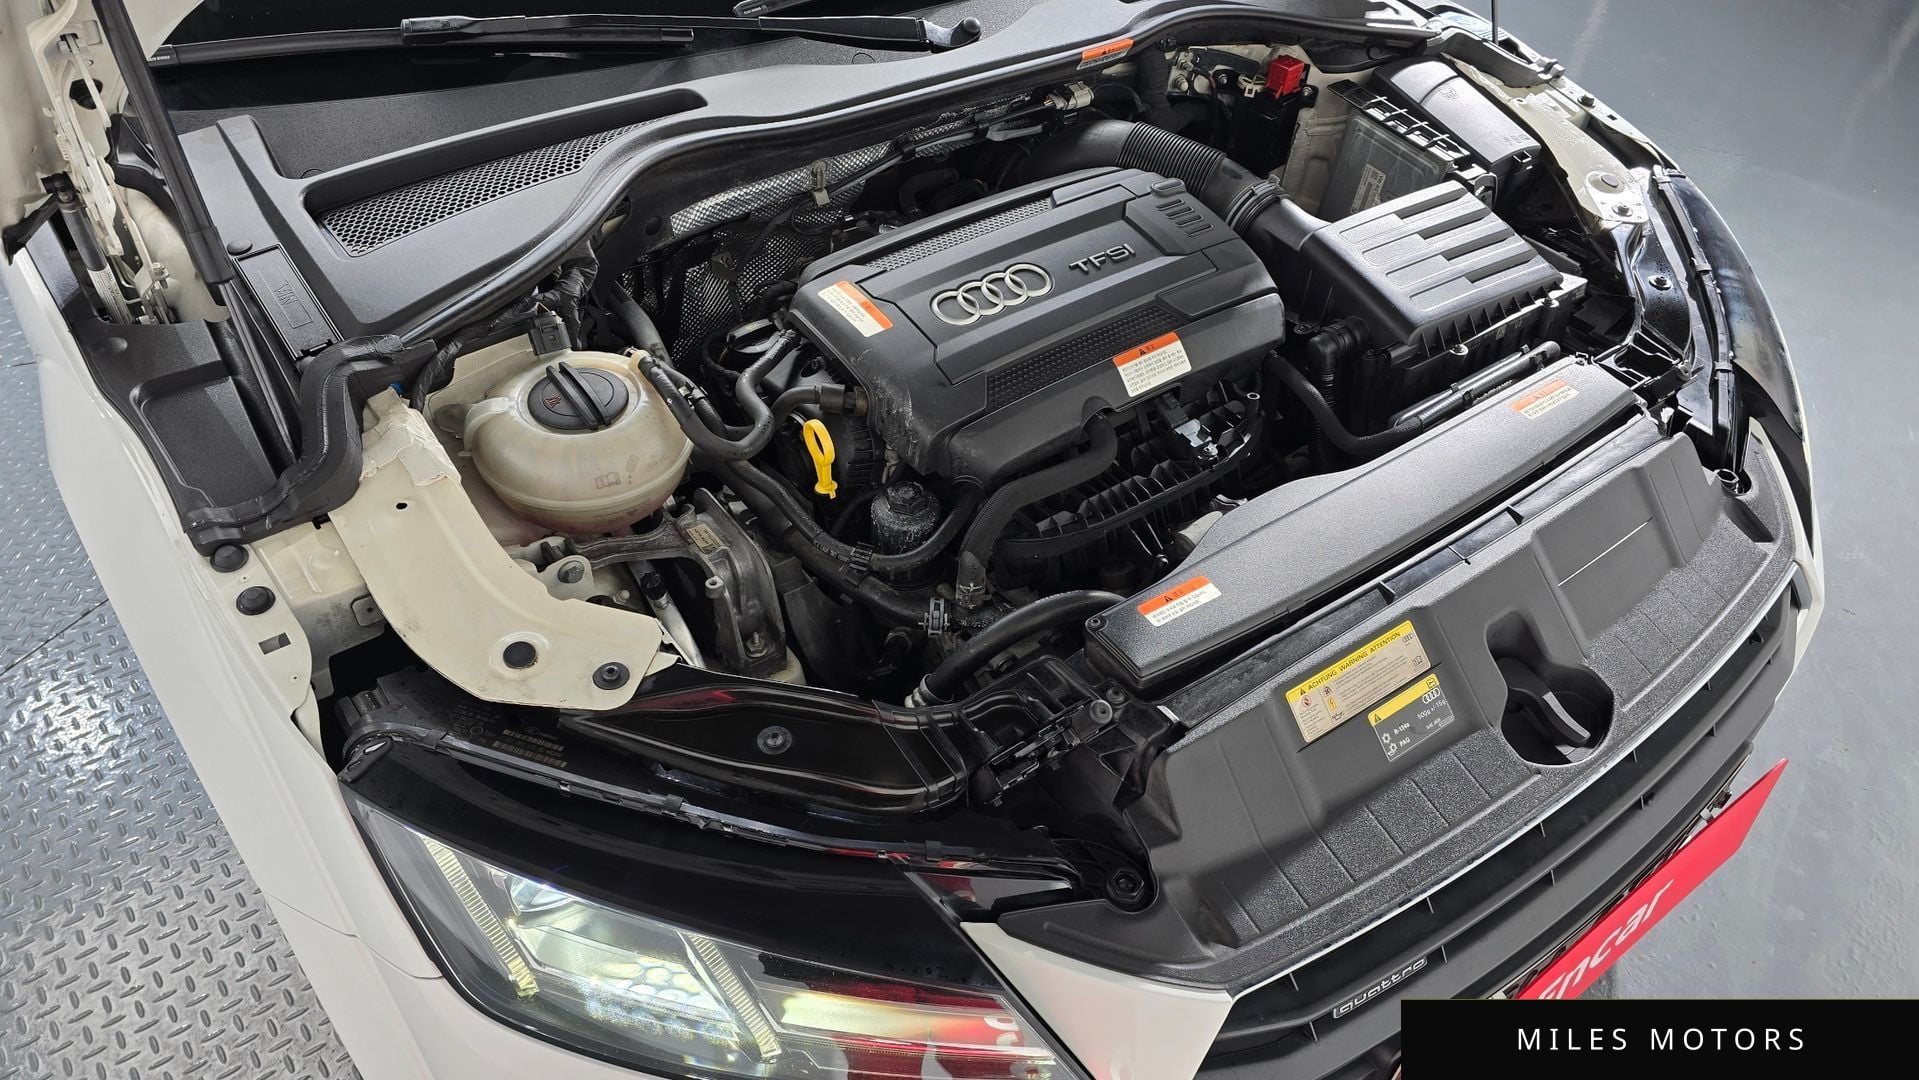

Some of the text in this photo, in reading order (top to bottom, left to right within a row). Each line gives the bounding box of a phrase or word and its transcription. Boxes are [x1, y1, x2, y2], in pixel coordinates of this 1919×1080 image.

[1068, 243, 1136, 274] TFSI
[1308, 631, 1401, 691] ACHTUNG WARNING ATTENTION
[1399, 736, 1411, 747] PAG
[1338, 958, 1426, 1015] quattro
